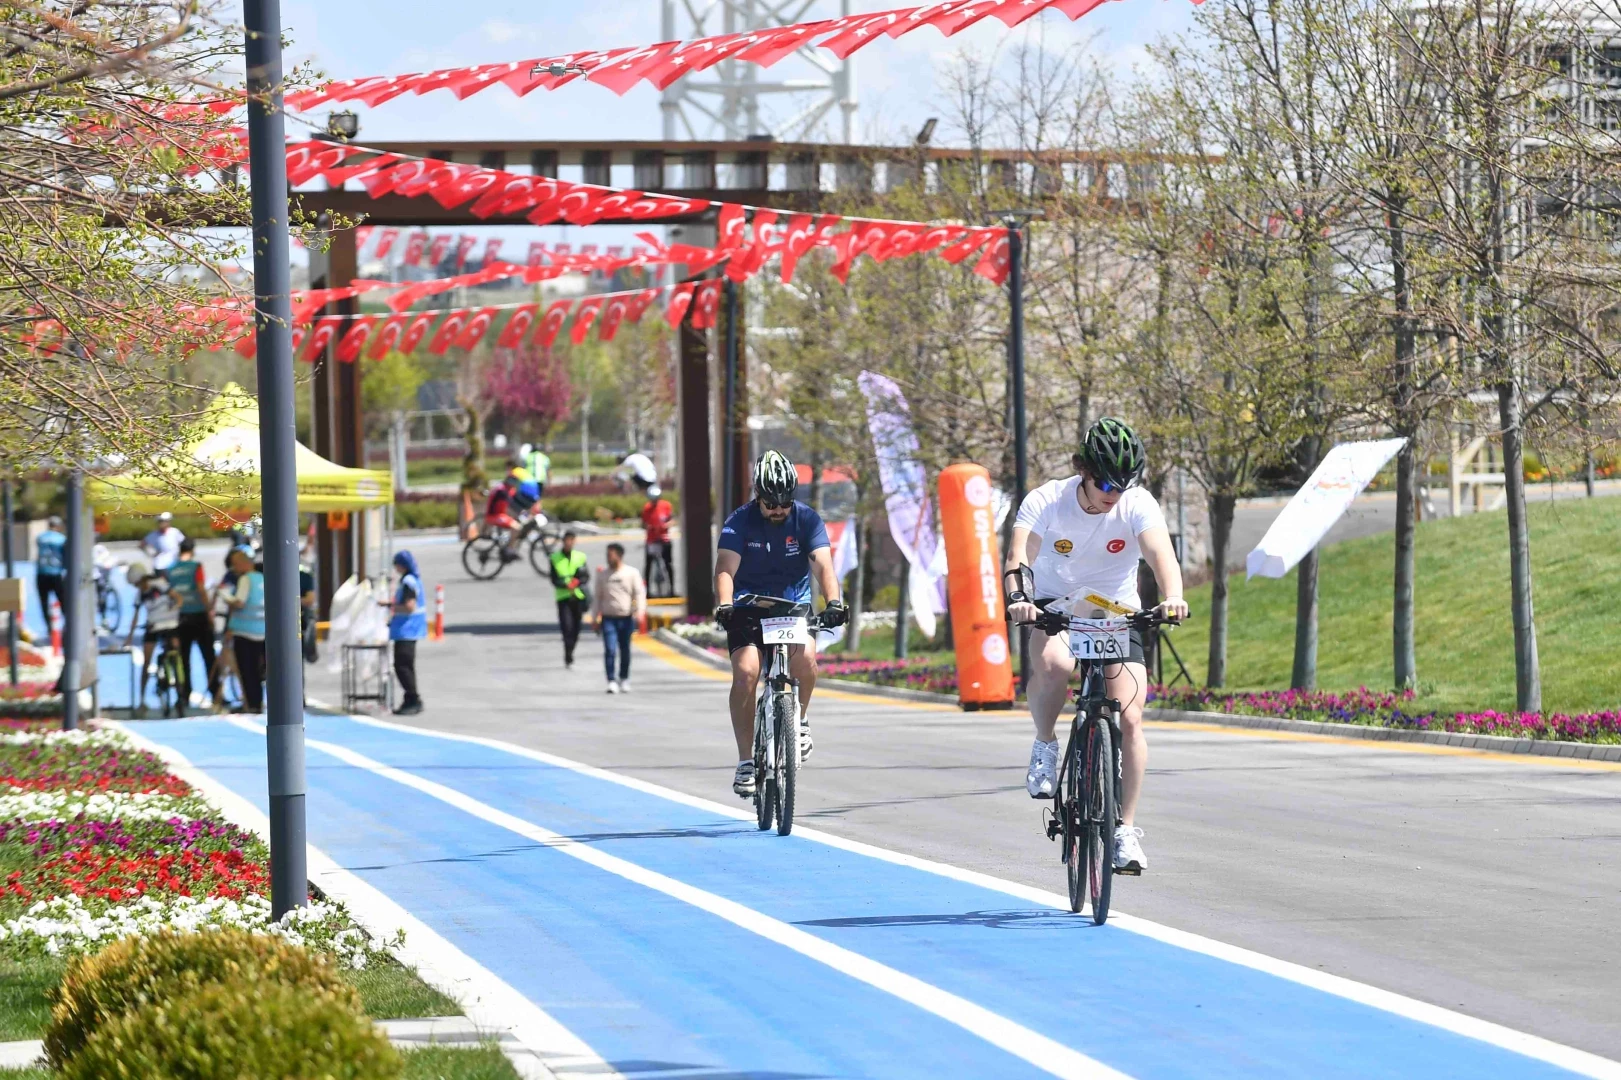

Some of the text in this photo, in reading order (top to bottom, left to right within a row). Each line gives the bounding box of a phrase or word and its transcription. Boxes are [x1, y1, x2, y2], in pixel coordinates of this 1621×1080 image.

[973, 509, 997, 619] START
[777, 629, 794, 640] 26
[1082, 639, 1116, 654] 103
